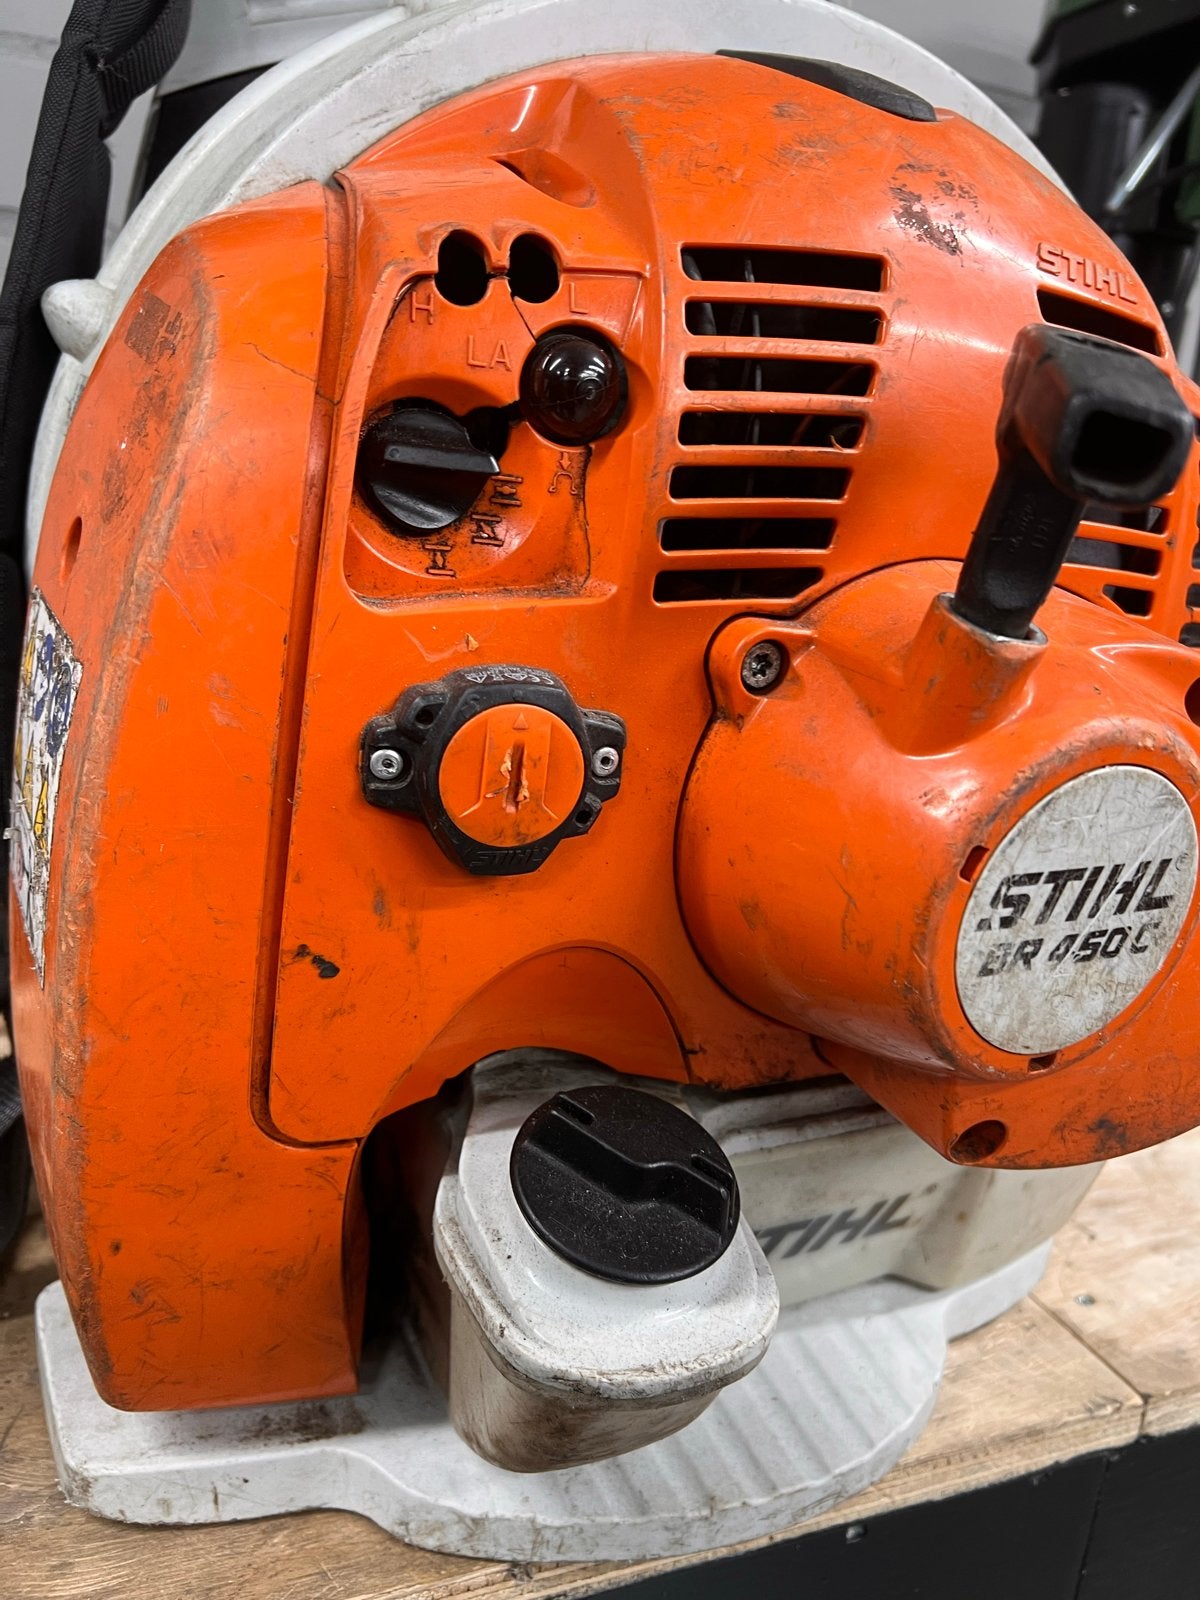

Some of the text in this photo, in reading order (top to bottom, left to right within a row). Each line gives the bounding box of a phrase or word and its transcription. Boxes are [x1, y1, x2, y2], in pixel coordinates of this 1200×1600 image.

[1037, 242, 1137, 304] STIHL
[411, 291, 435, 324] H
[569, 282, 588, 315] L
[467, 334, 512, 372] LA
[974, 858, 1174, 931] STIHL
[754, 1193, 912, 1259] TIHL
